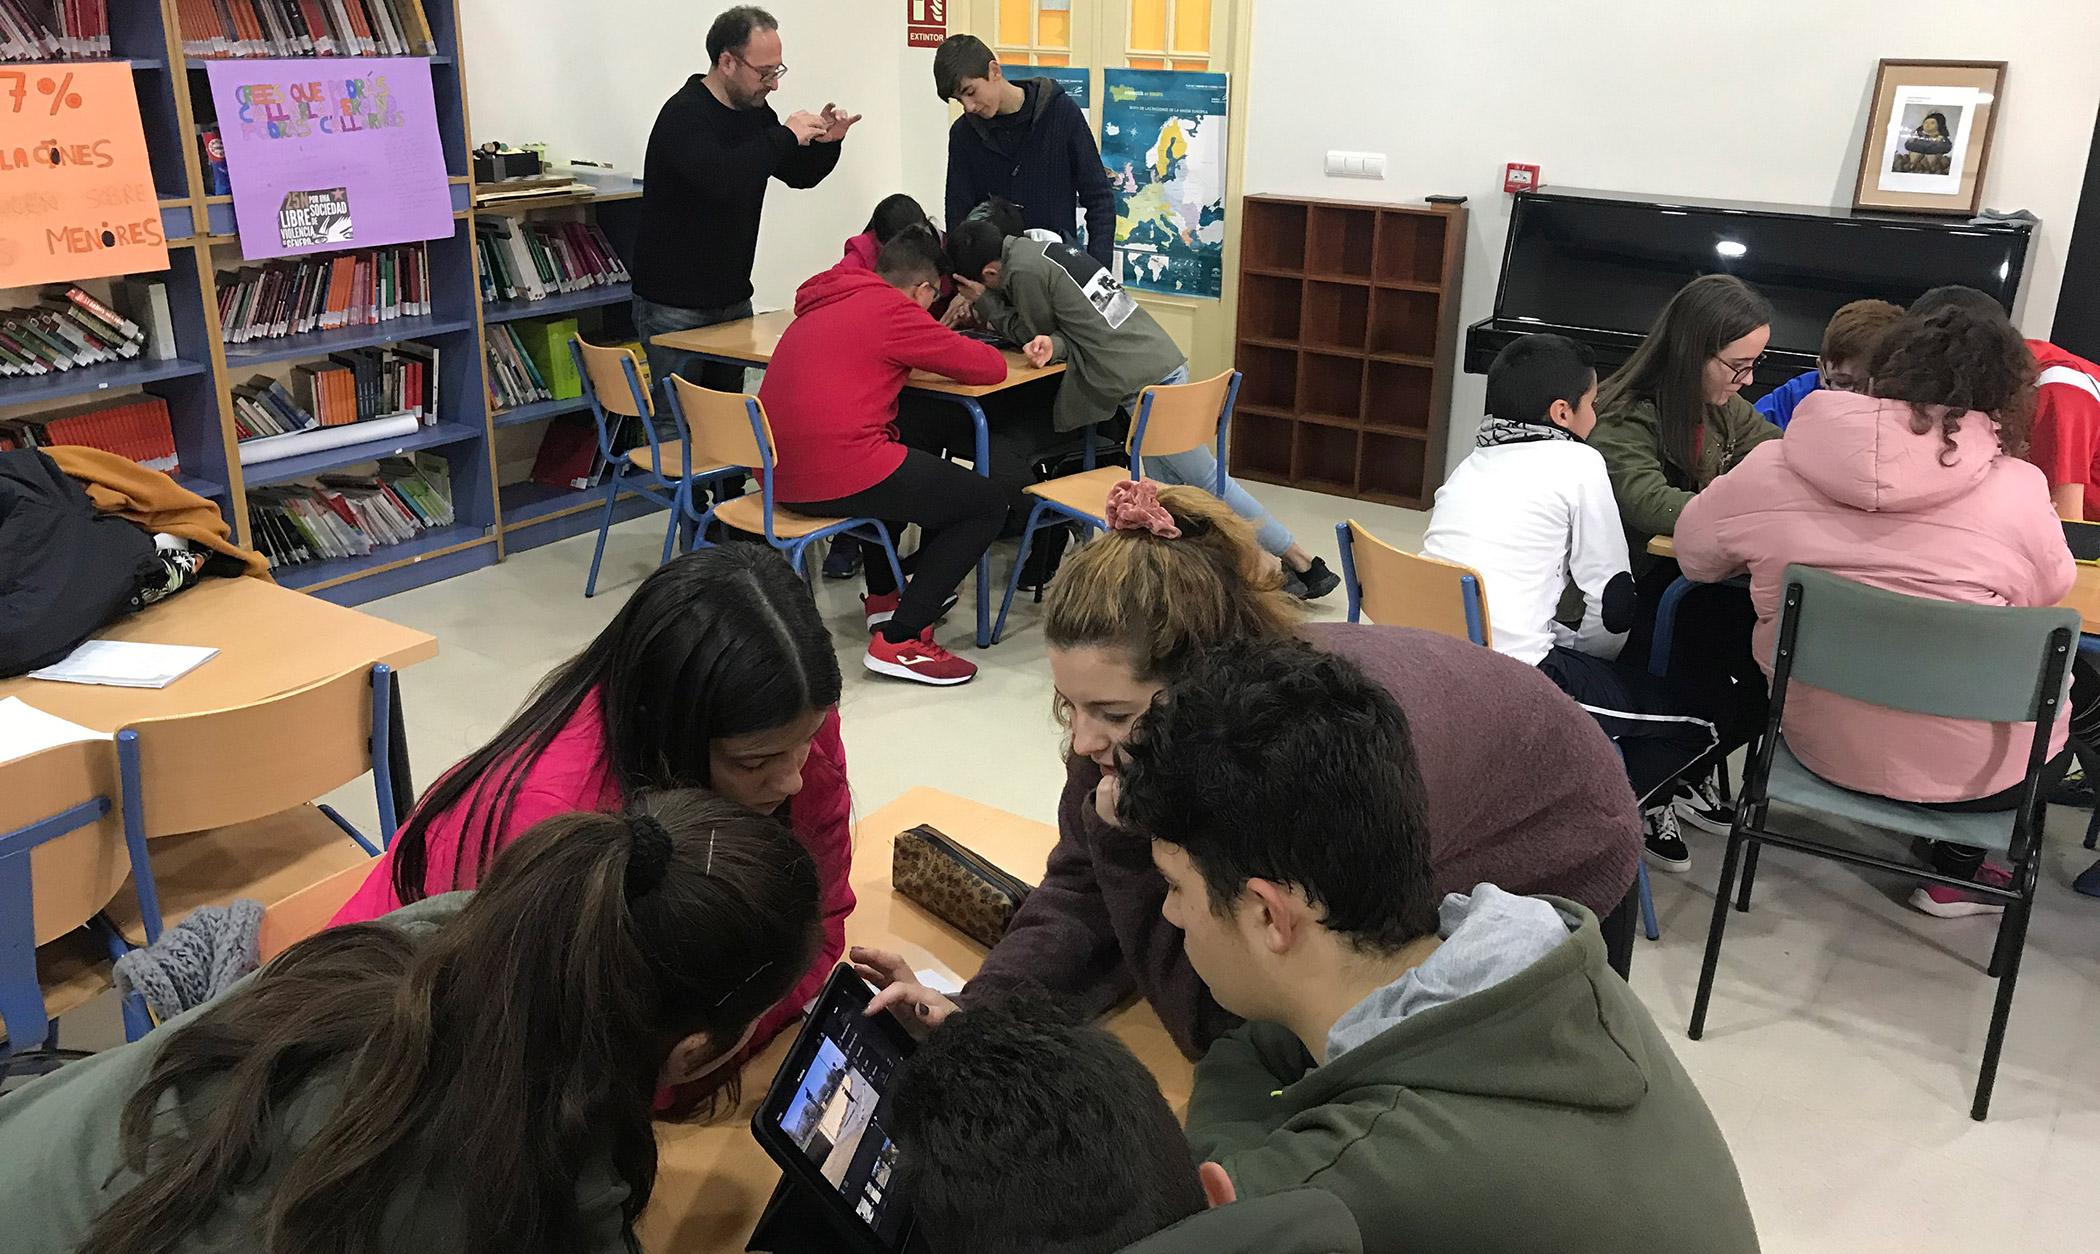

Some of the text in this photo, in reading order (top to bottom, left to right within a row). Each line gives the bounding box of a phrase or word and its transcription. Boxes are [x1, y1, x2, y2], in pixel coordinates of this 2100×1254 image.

[910, 32, 944, 42] EXTINTOR
[235, 83, 285, 105] CREES
[290, 82, 325, 103] QUE
[280, 208, 312, 228] LIBRE
[309, 201, 347, 217] SOCIEDAD
[45, 217, 163, 255] MENORES
[280, 226, 315, 240] VIOLENCIA
